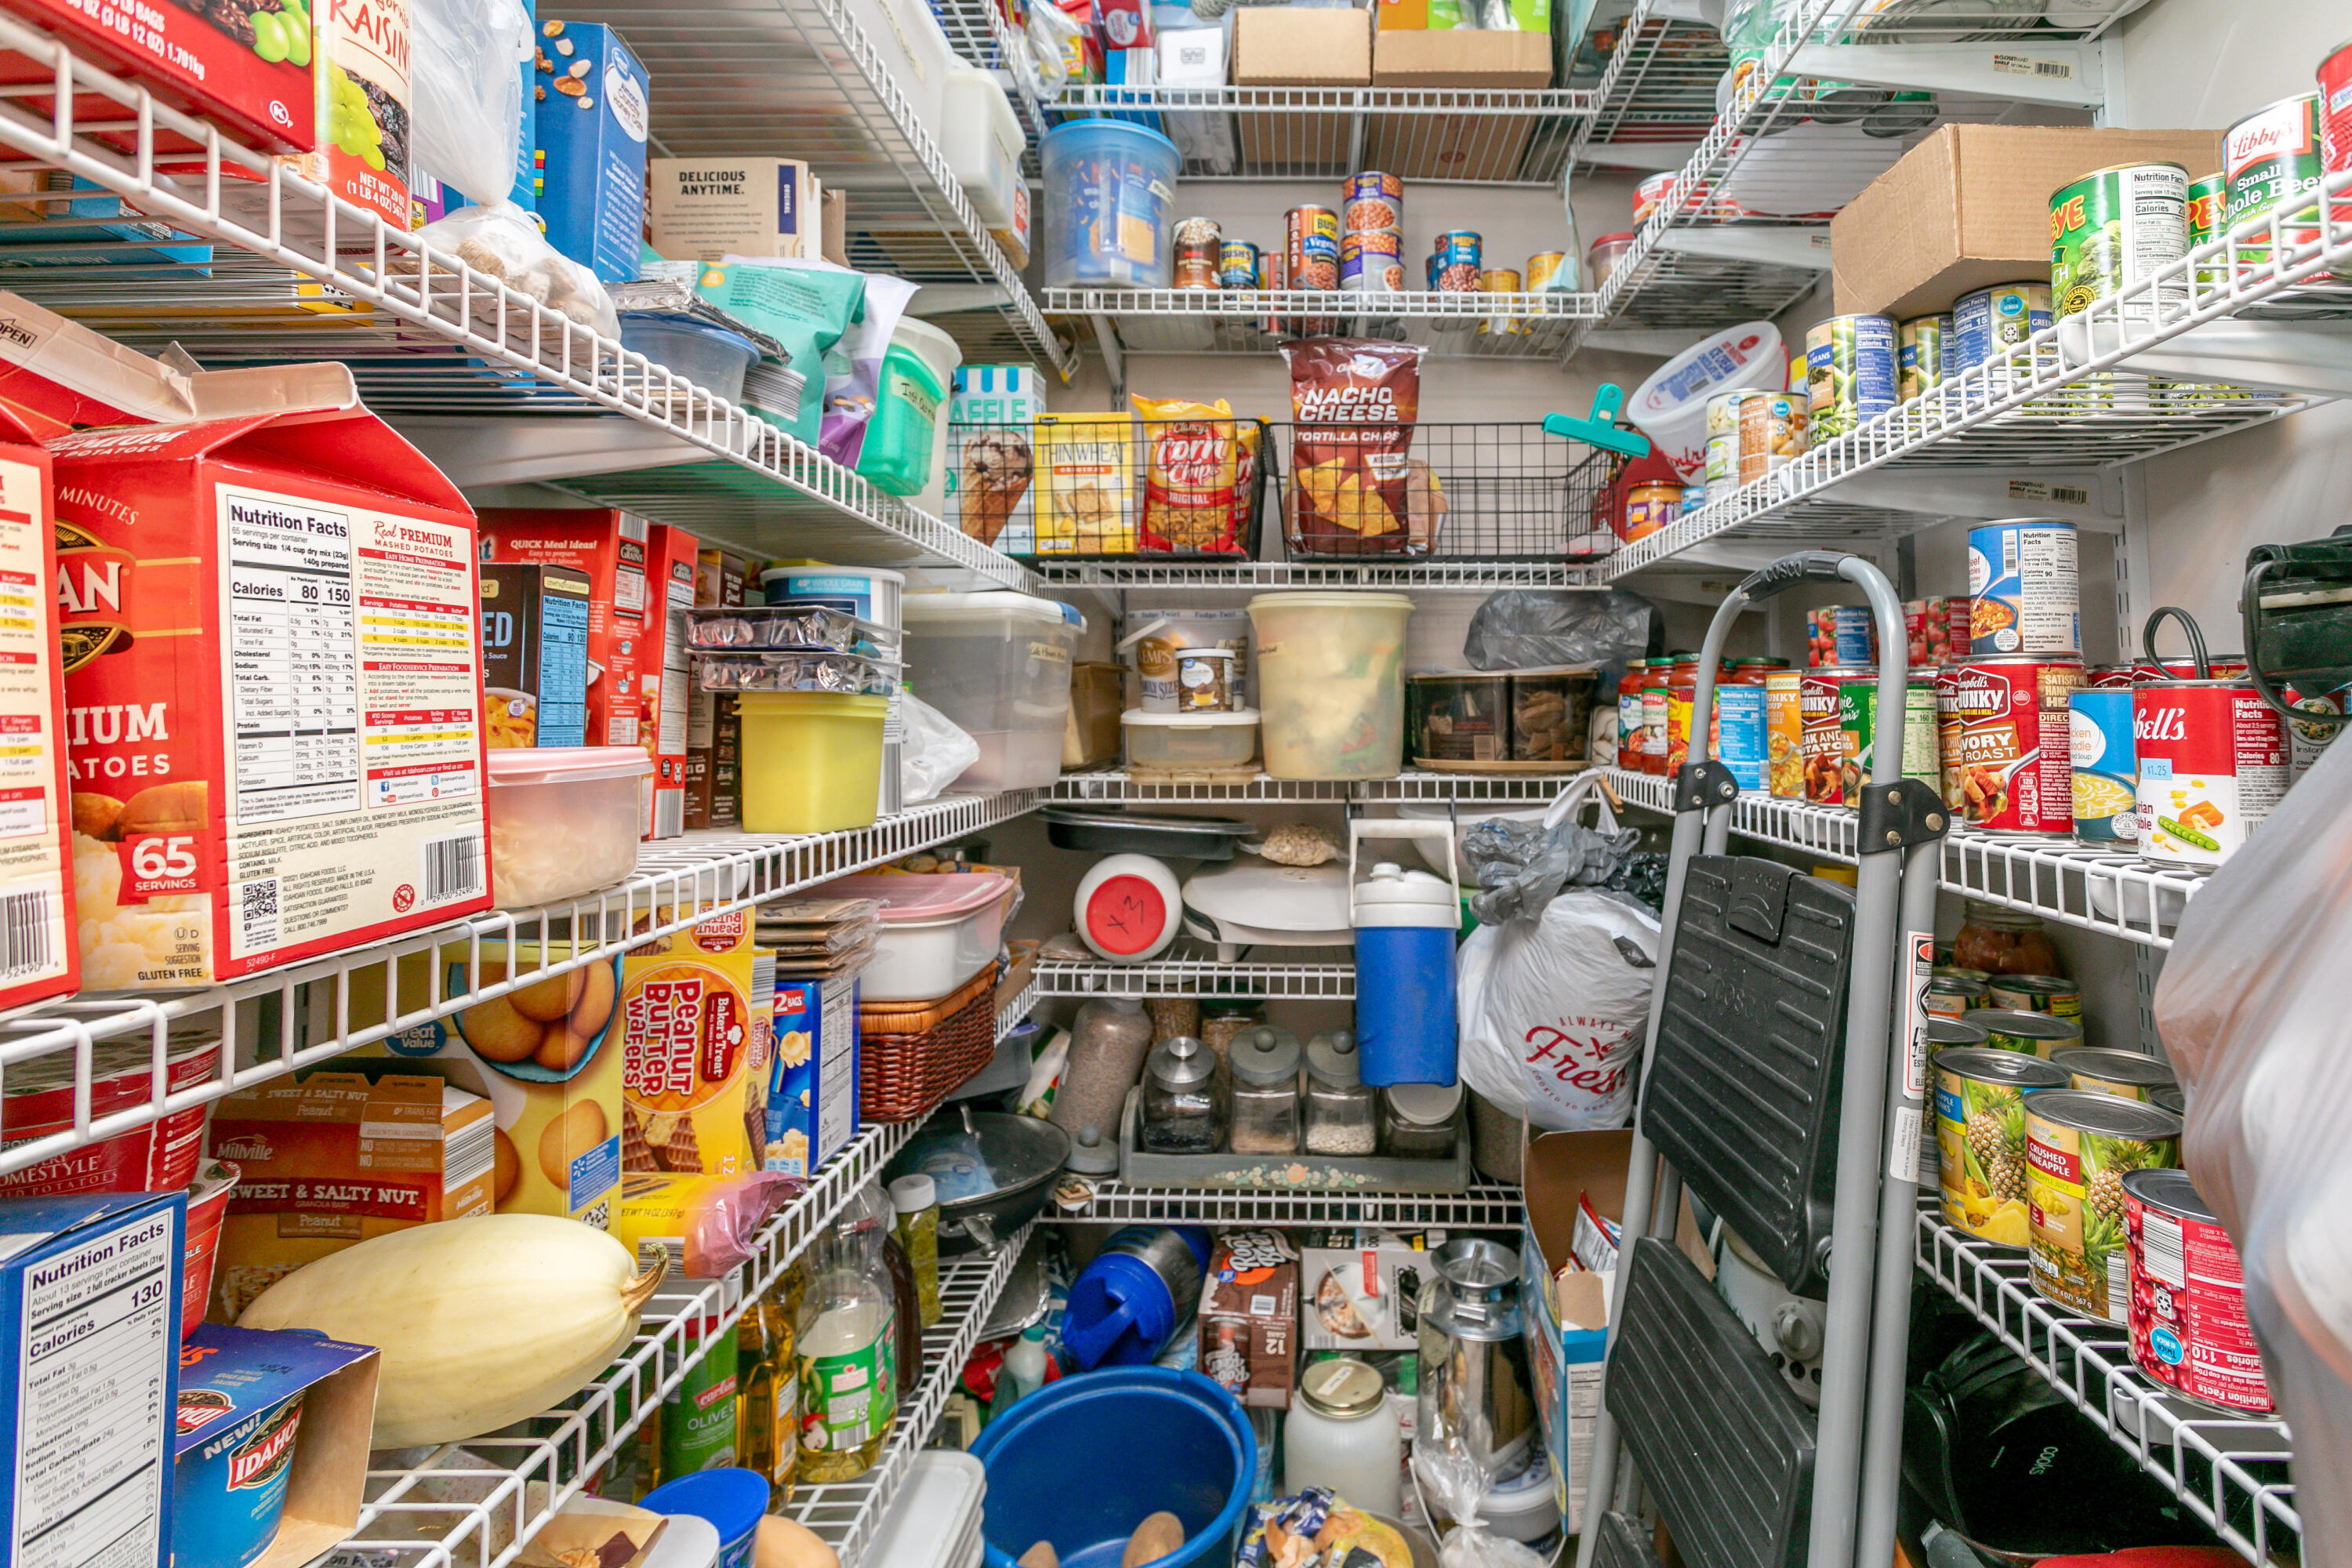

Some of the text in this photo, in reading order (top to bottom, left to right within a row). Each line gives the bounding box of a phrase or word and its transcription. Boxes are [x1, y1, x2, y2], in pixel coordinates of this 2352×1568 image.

[114, 12, 146, 45] LB 12
[359, 171, 390, 197] NET WT
[679, 170, 746, 183] DELICIOUS
[2134, 172, 2170, 183] Nutrition
[2237, 164, 2283, 193] Small
[359, 184, 379, 204] LB 4
[681, 183, 745, 196] ANYTIME.
[2135, 205, 2170, 214] Calories
[1976, 316, 1987, 326] 15
[2031, 318, 2053, 328] GREEN
[1886, 339, 1893, 347] 15
[1811, 351, 1831, 365] BEANS
[1305, 387, 1393, 405] NACHO
[1298, 405, 1399, 422] CHEESE
[1172, 421, 1210, 435] Clancy's
[1296, 431, 1401, 442] TORTILLA CHIPS
[64, 445, 162, 459] POTATOES
[1038, 443, 1127, 465] THIN WHEAT
[1156, 437, 1225, 470] Corn
[1168, 460, 1220, 487] Chips
[59, 485, 140, 525] MINUTES
[1168, 492, 1210, 505] ORIGINAL
[230, 505, 347, 538] Nutrition Facts
[372, 521, 452, 549] Real PREMIUM
[232, 538, 259, 550] Serving
[375, 539, 454, 558] MASHED POTATOES
[510, 539, 598, 550] QUICK Meal Ideas!
[620, 549, 644, 564] GRAINS
[321, 559, 350, 570] prepared
[1766, 559, 1802, 583] COSCO
[811, 578, 865, 588] WHOLE GRAIN
[232, 581, 350, 603] Calories 80 150
[543, 597, 587, 610] Nutrition Facts
[1141, 611, 1160, 619] Fudge
[1195, 611, 1217, 619] Fudge
[567, 633, 575, 641] 90
[2045, 674, 2078, 685] SATISFY
[1919, 713, 1929, 722] 160
[2235, 709, 2263, 719] Facts
[1966, 746, 2016, 763] ROAST
[2237, 751, 2281, 765] Calories 80
[2147, 764, 2167, 777] $1.25
[131, 835, 197, 880] 65
[238, 866, 275, 880] GLUTEN FREE
[134, 877, 197, 892] SERVINGS
[283, 911, 311, 926] QUESTIONS
[283, 924, 296, 935] CALL
[175, 942, 200, 953] SERVING
[164, 953, 201, 966] SUGGESTION
[245, 953, 277, 968] 52490-F
[137, 967, 203, 982] GLUTEN FREE
[787, 995, 803, 1007] BAGS
[1559, 1015, 1616, 1032] ALWAYS
[401, 1037, 436, 1049] Value
[713, 996, 730, 1078] Baker's Treat
[267, 1088, 370, 1102] SWEET SALTY NUT
[296, 1105, 334, 1118] Peanut
[404, 1106, 438, 1116] TRANS FAT
[216, 1138, 274, 1161] Millville
[361, 1139, 374, 1152] NO
[359, 1154, 372, 1167] NO
[2029, 1142, 2067, 1167] CRUSHED
[2028, 1150, 2071, 1178] PINEAPPLE
[31, 1170, 118, 1196] POTATOES
[2055, 1178, 2070, 1192] JUICE
[229, 1182, 419, 1207] SWEET & SALTY NUT
[295, 1200, 351, 1210] GRANOLA BARS
[299, 1214, 342, 1229] Peanut
[32, 1223, 165, 1291] Nutrition Facts
[1219, 1233, 1255, 1272] Root
[31, 1271, 104, 1308] About servings
[131, 1279, 163, 1308] 130
[31, 1292, 82, 1319] Serving size
[2074, 1294, 2086, 1308] 567
[29, 1319, 96, 1358] Calories
[1265, 1339, 1287, 1356] 12
[2192, 1347, 2216, 1364] 110
[2192, 1366, 2222, 1379] cup (70g)
[28, 1373, 51, 1390] Total
[2197, 1383, 2269, 1407] Nutrition Facts
[687, 1402, 729, 1431] OLIVE
[25, 1425, 74, 1458] Cholesterol
[202, 1412, 262, 1461] NEW!
[24, 1436, 102, 1485] Total Carbohydrate
[24, 1449, 57, 1472] Sodium
[2028, 1446, 2059, 1475] cooks
